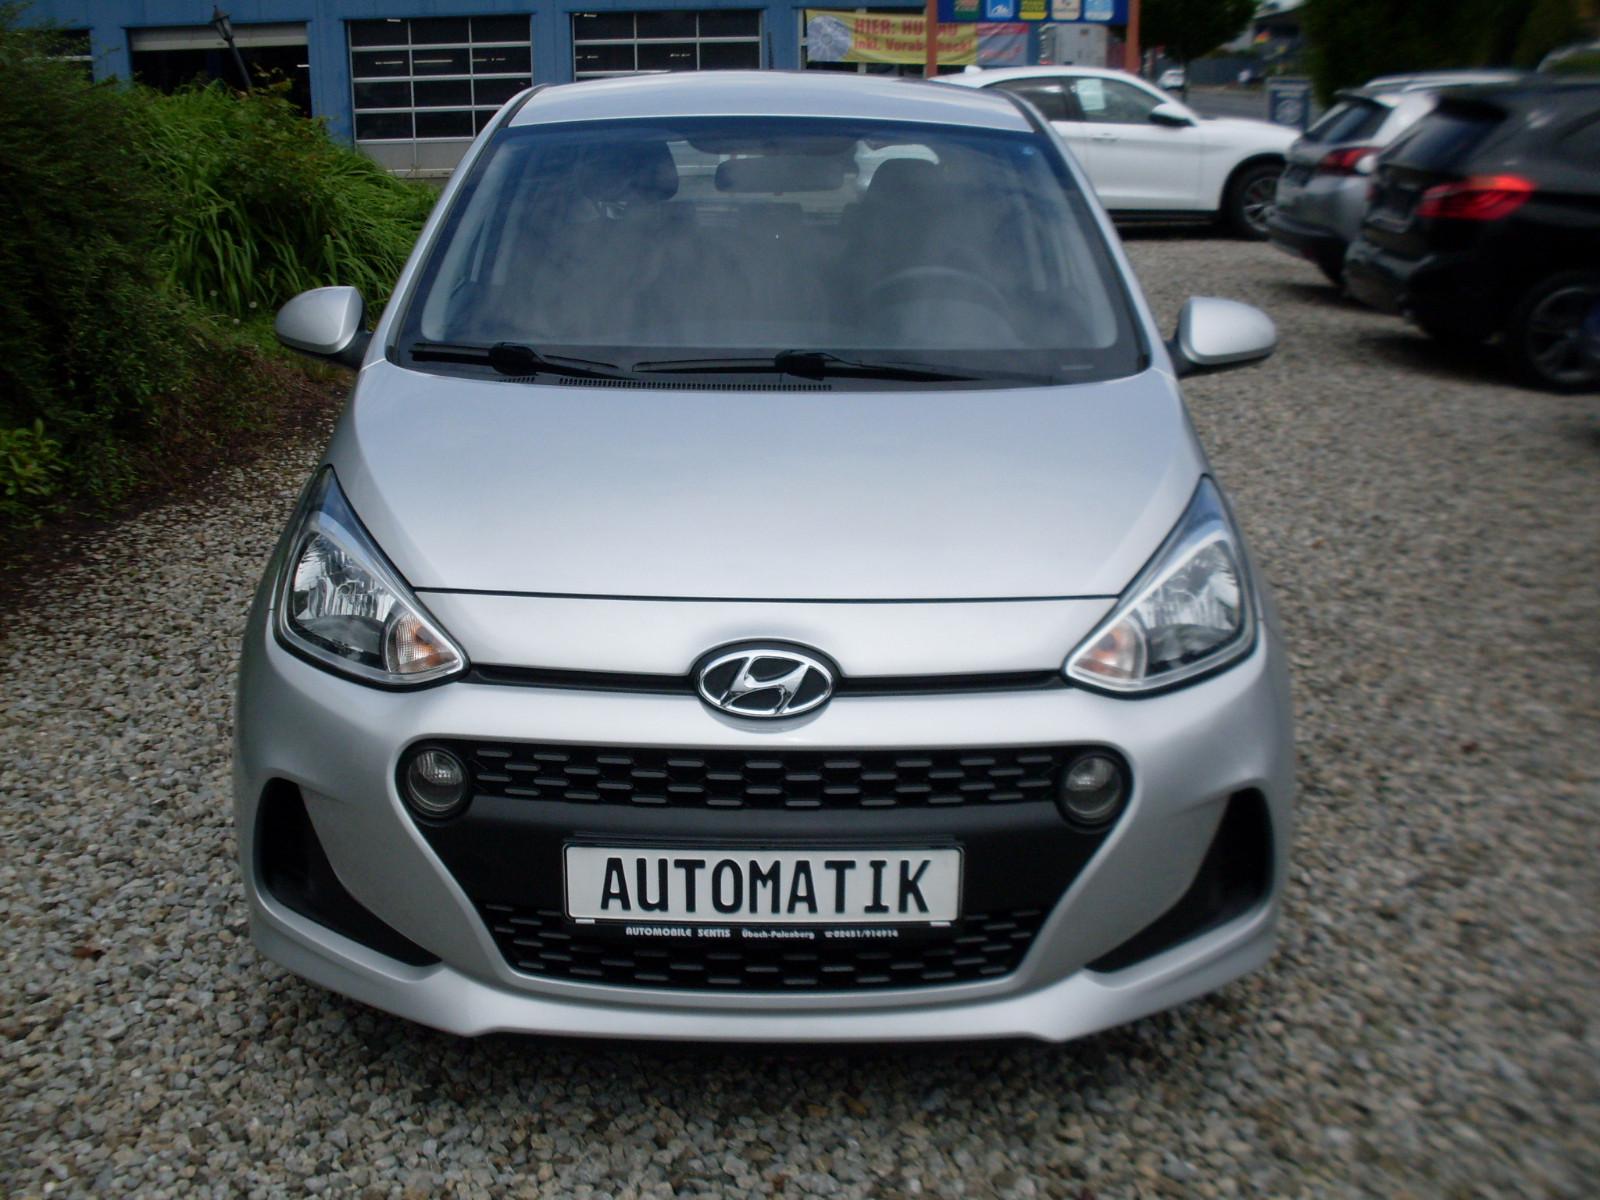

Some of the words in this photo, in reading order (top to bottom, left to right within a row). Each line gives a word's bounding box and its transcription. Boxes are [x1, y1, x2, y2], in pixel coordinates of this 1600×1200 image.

[600, 857, 931, 914] AUTOMATIK
[625, 927, 692, 938] AUTOMOBILE
[697, 928, 731, 938] SENTIS
